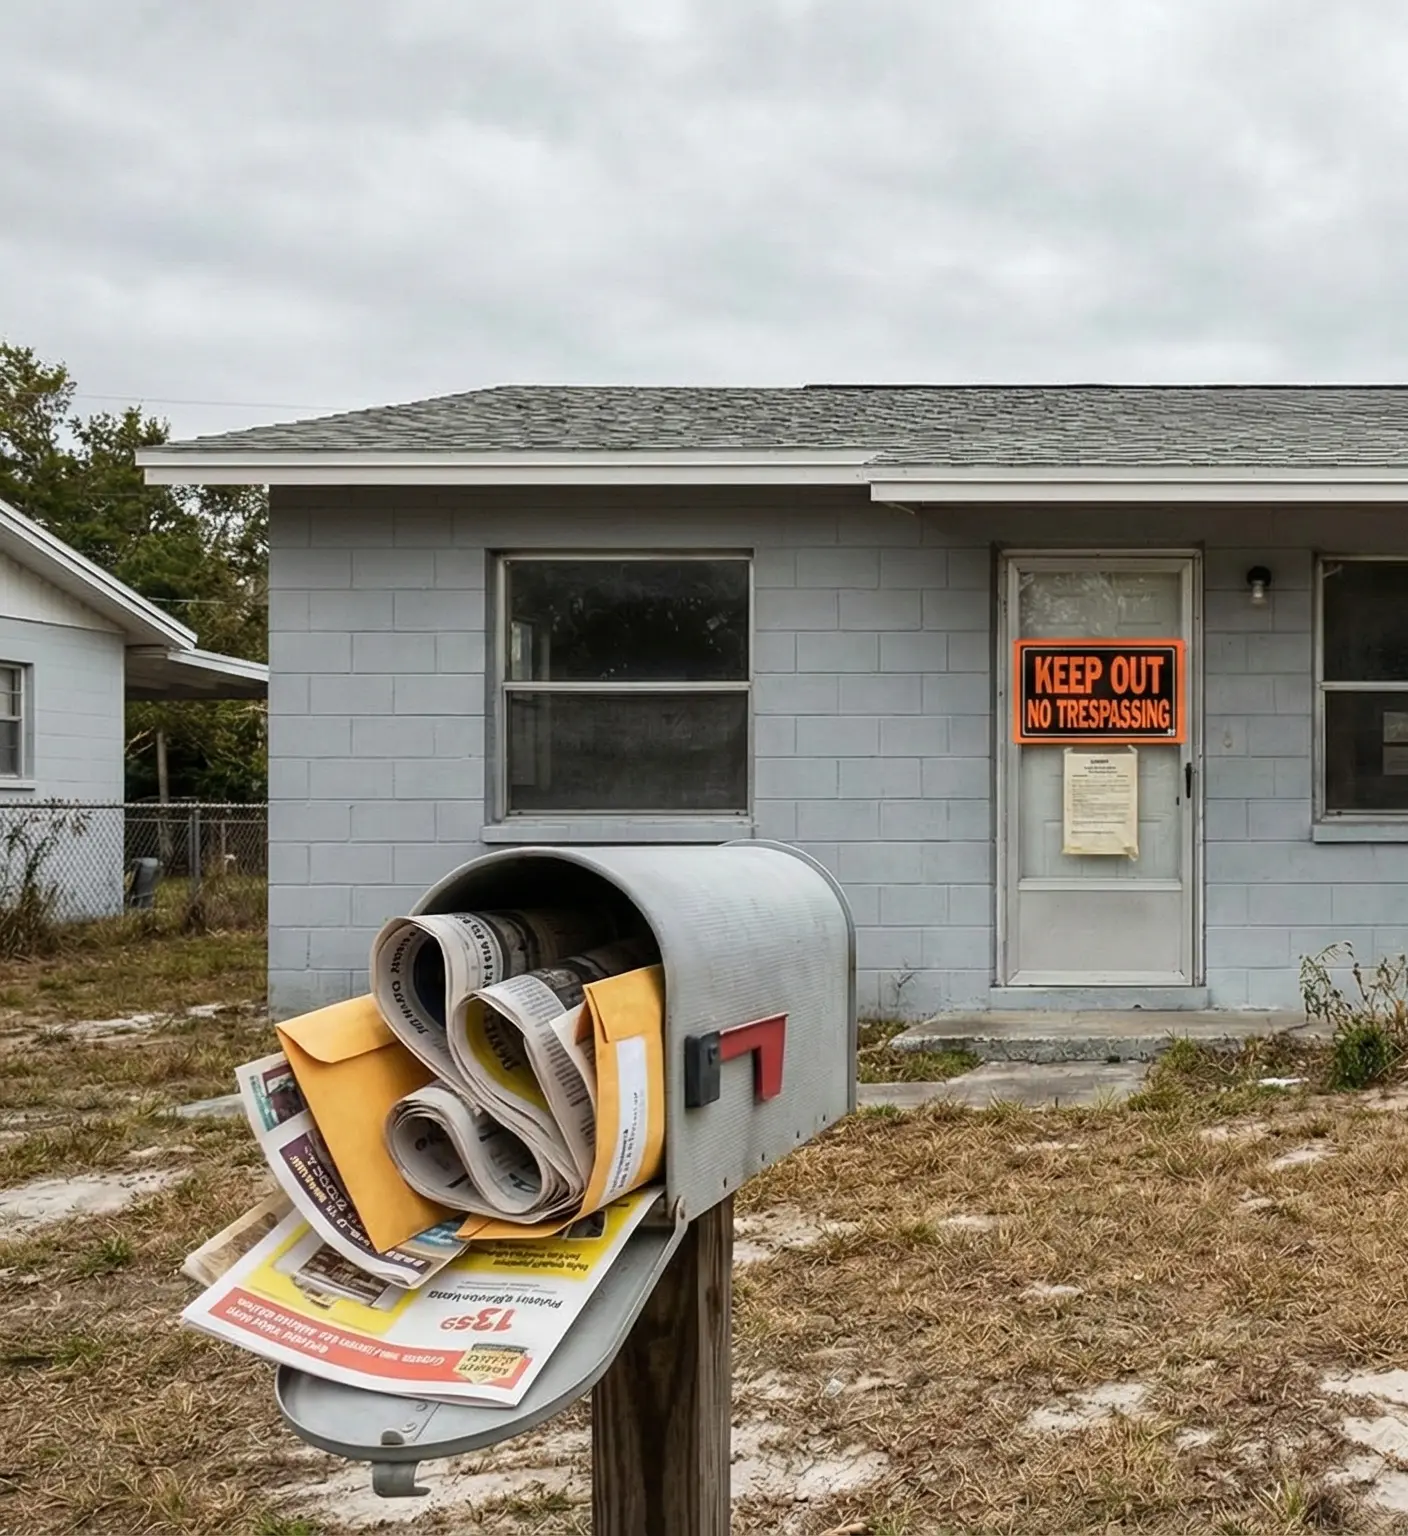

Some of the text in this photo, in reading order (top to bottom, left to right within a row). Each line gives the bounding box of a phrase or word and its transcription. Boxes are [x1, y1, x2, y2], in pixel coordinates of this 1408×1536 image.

[1035, 655, 1164, 695] KEEP OUT
[1028, 699, 1170, 729] NO TRESPASSING
